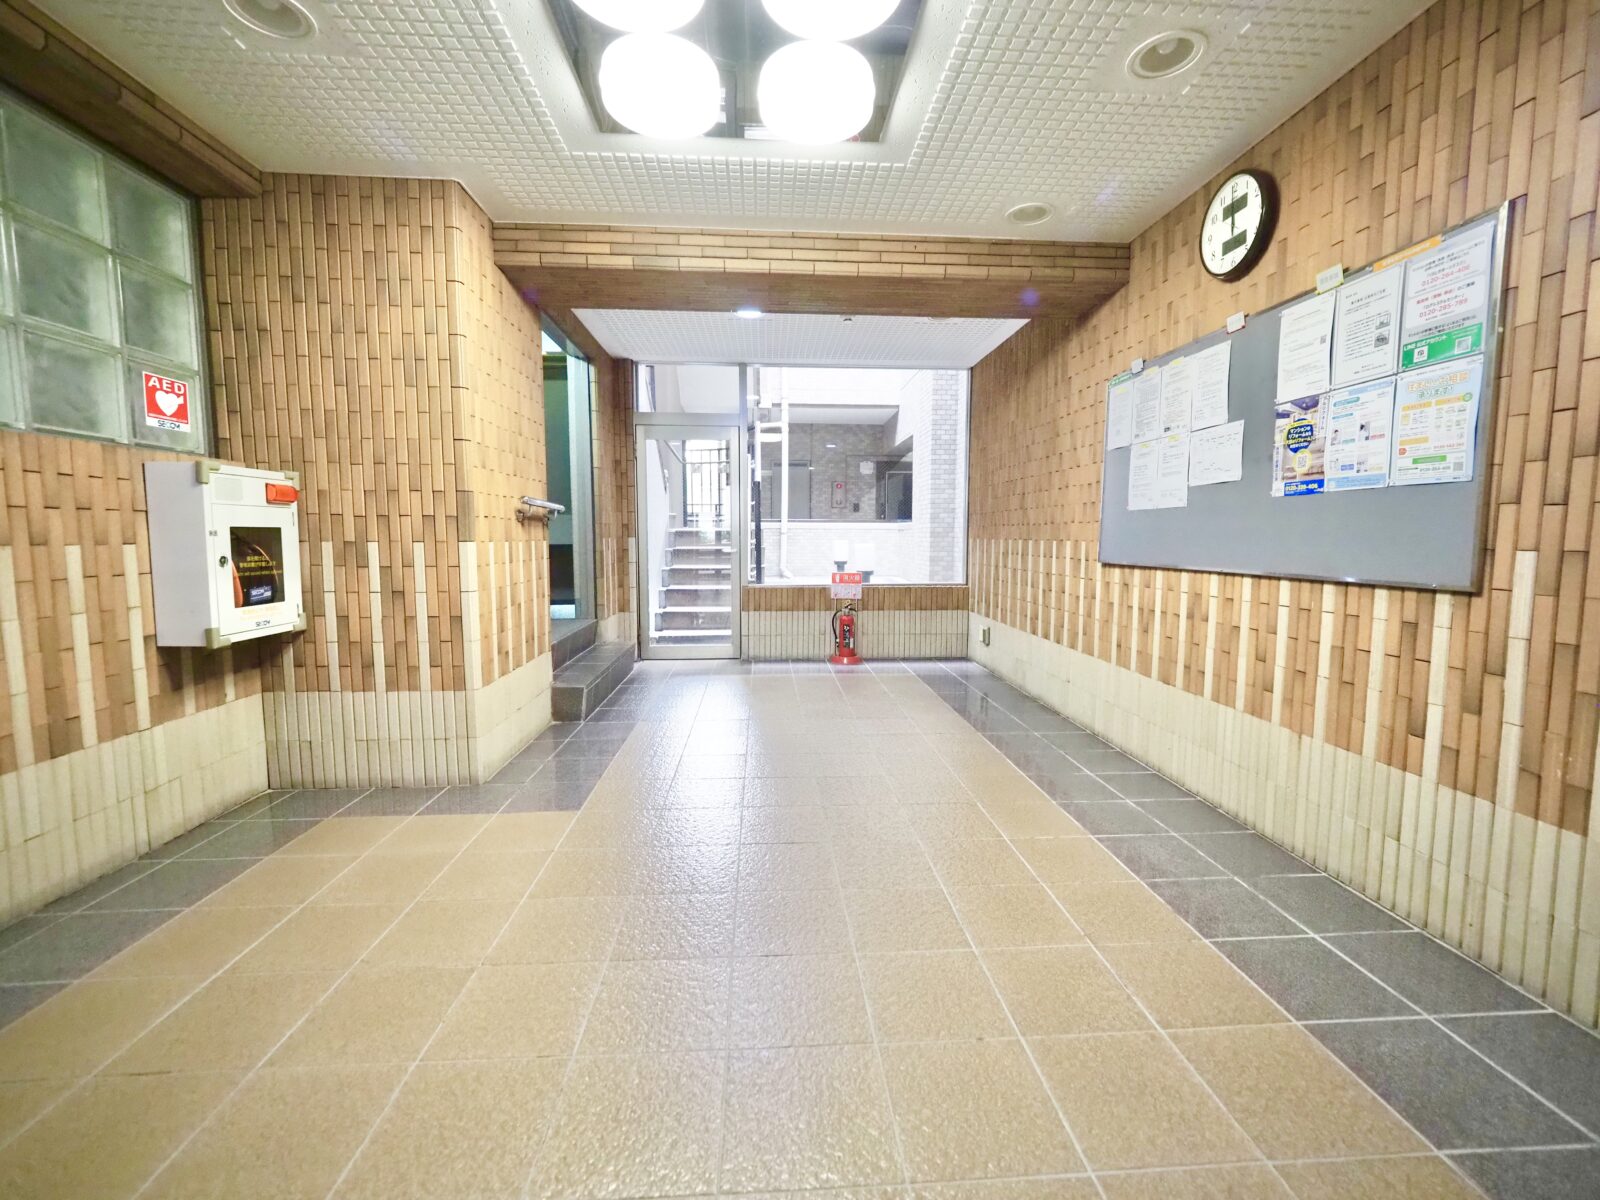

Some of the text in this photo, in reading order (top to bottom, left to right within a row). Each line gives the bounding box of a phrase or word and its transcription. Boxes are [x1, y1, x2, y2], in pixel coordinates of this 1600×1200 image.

[148, 376, 185, 395] AED
[157, 419, 181, 430] SECOM
[255, 619, 271, 628] SECOM
